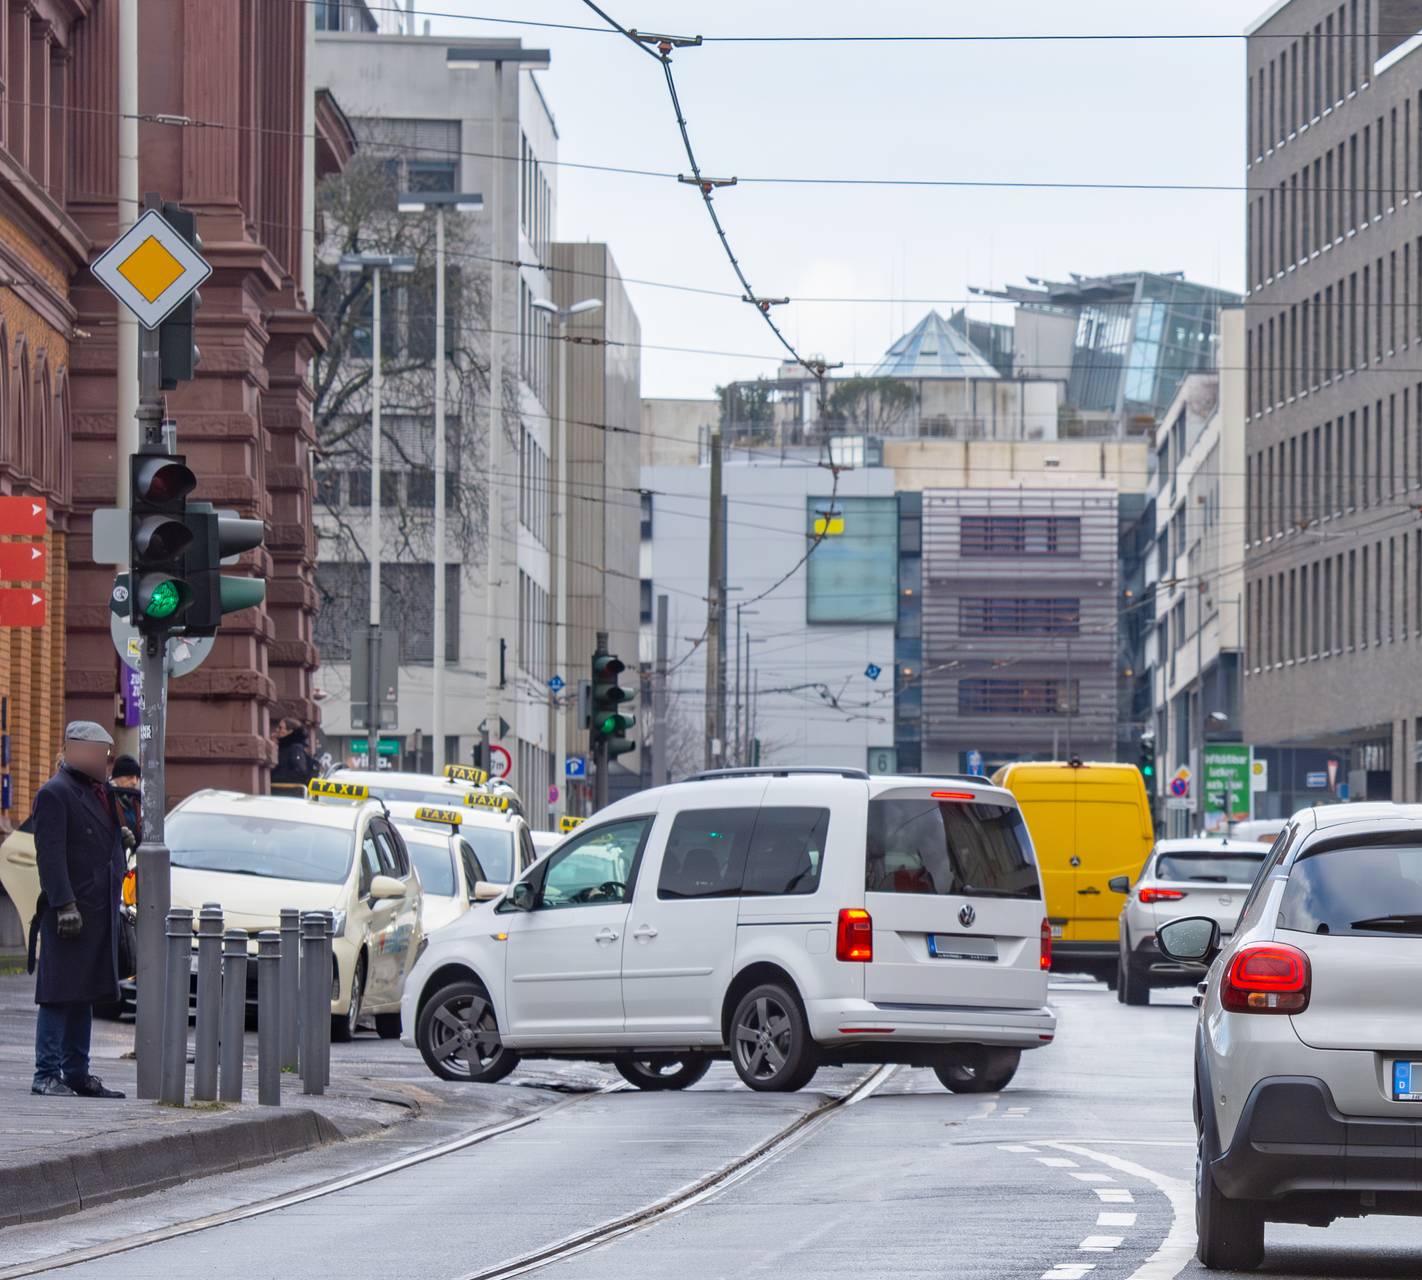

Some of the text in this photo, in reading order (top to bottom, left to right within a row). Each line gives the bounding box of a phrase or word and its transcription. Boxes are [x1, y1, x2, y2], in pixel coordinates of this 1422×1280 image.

[451, 767, 479, 781] TAXI
[317, 780, 359, 797] TAXI
[472, 792, 500, 807] TAXI
[424, 808, 456, 821] TAXI
[1398, 1081, 1406, 1090] D
